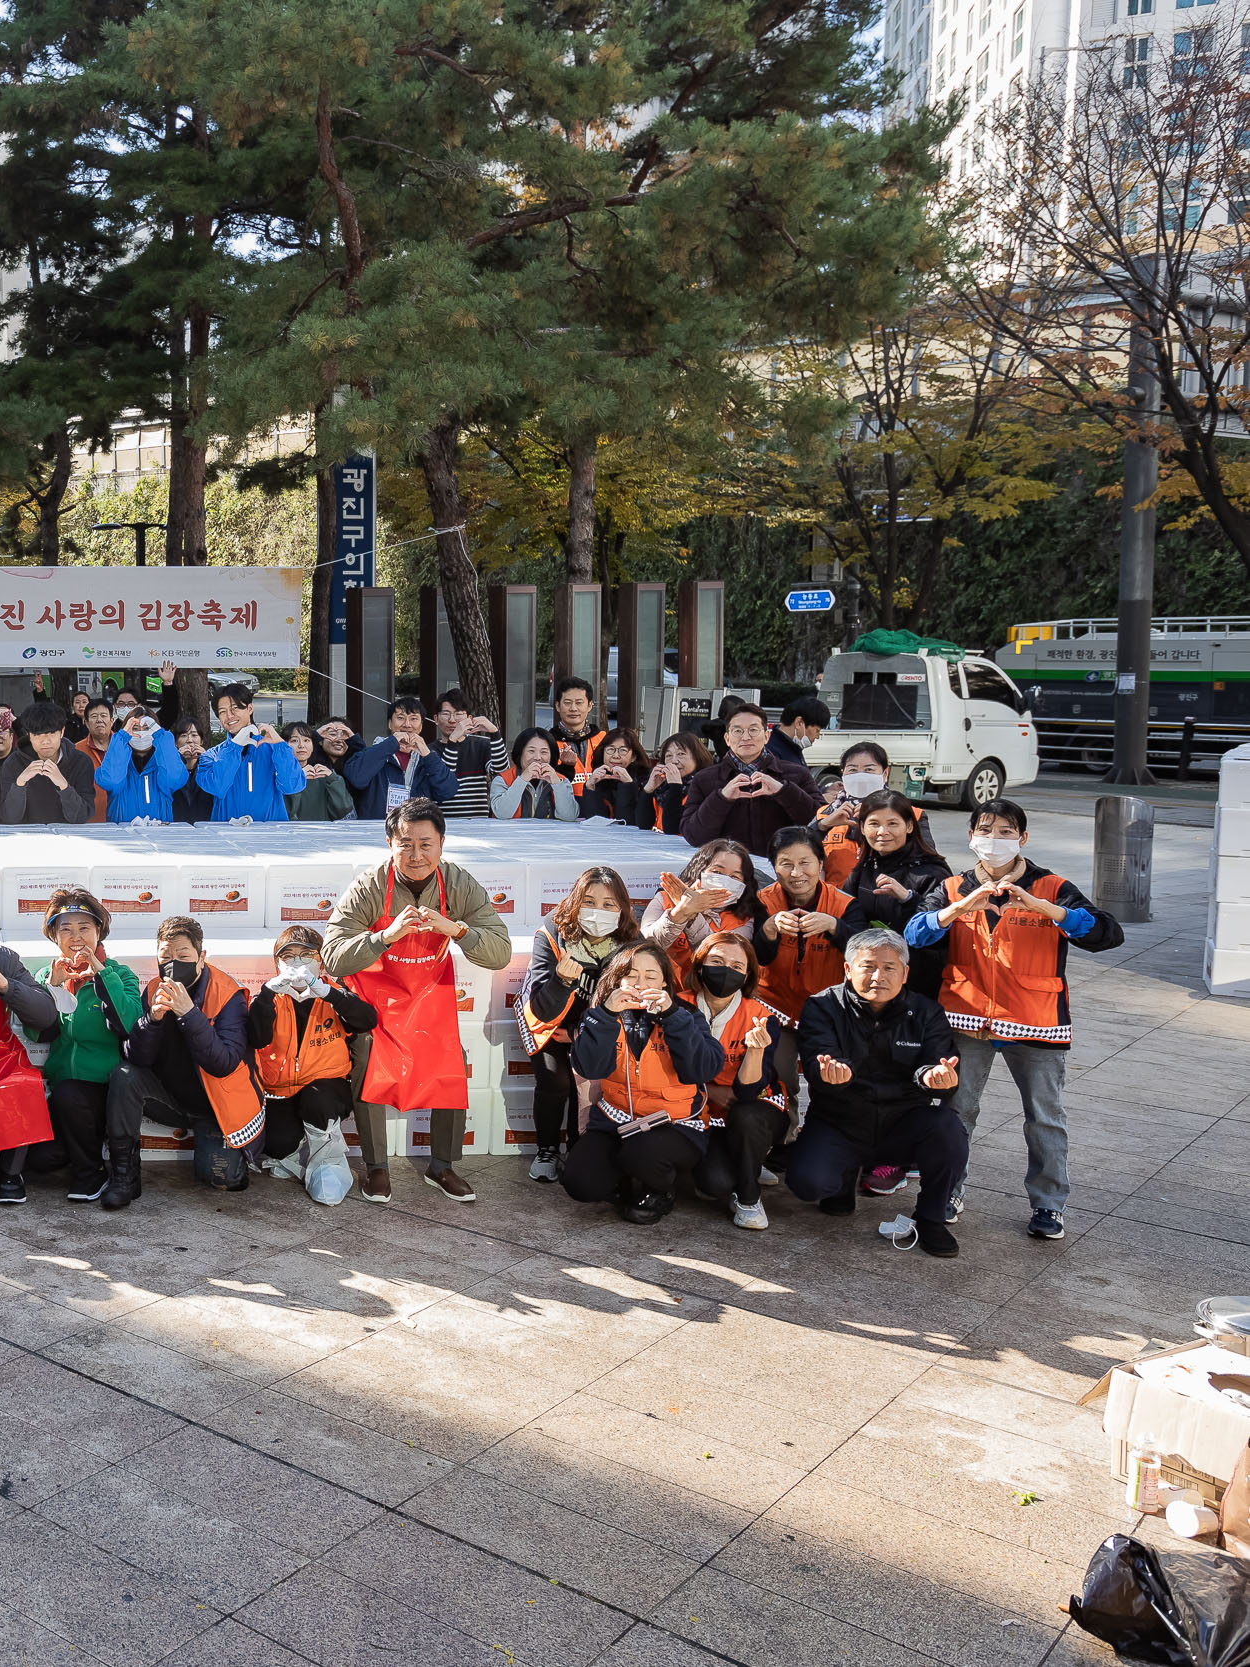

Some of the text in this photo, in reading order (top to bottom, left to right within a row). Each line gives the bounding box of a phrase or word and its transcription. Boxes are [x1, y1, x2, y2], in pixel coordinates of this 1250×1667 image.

[35, 599, 126, 632] 사랑의
[137, 599, 258, 632] 김장축제
[39, 649, 65, 657] 광진구
[1047, 650, 1073, 659] 쾌적한
[1075, 650, 1096, 660] 환경,
[1149, 650, 1168, 659] 들어
[1171, 650, 1200, 660] 갑니다
[388, 954, 399, 963] 광진
[416, 954, 436, 963] 김장축제
